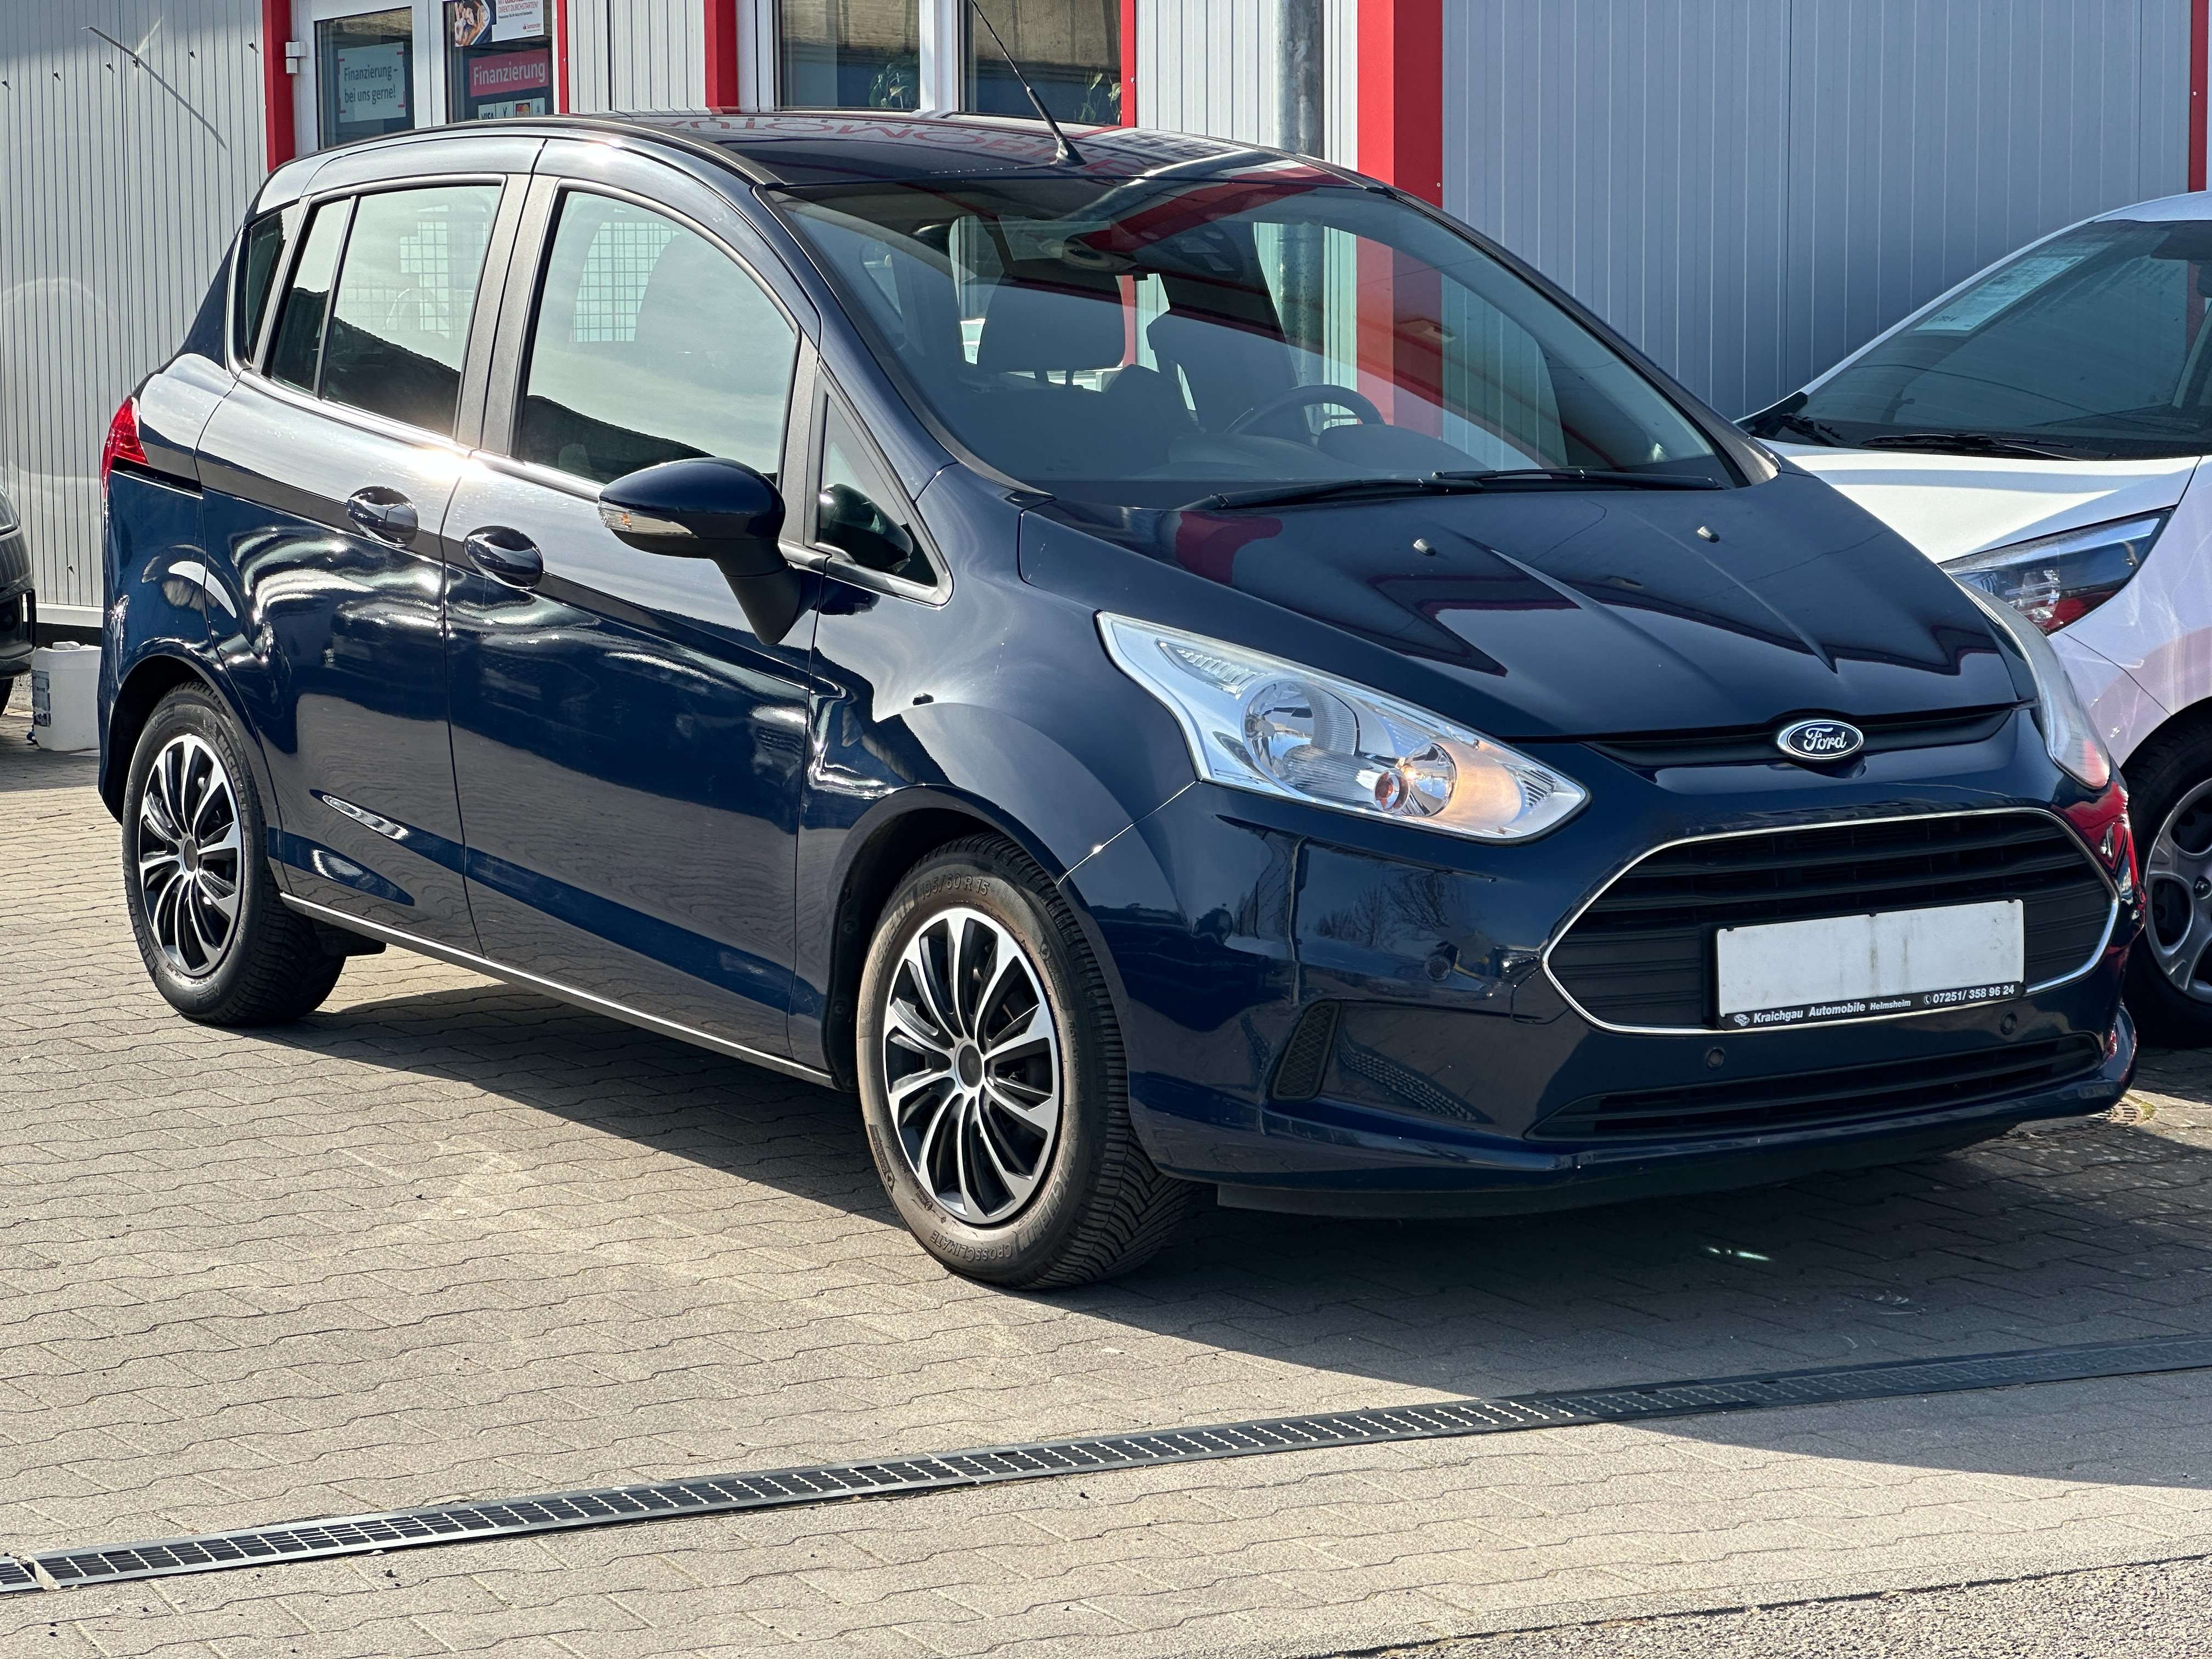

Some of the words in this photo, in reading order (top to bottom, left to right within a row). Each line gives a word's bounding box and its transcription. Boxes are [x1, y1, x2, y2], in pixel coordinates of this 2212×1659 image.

[344, 64, 392, 81] Finanzierung
[473, 61, 545, 86] Finanzierung
[345, 88, 356, 103] bei
[358, 90, 370, 101] uns
[372, 84, 396, 105] gerne!
[1804, 727, 1847, 751] Ford
[922, 873, 961, 900] 195/60
[964, 875, 973, 891] R
[976, 878, 990, 895] 15
[1753, 1009, 1803, 1023] Kraichgau
[1809, 1002, 1865, 1017] Automobile
[1870, 999, 1911, 1011] Helmsheim
[1933, 990, 1966, 1003] 07251/
[1968, 988, 1987, 998] 358
[1989, 986, 2001, 996] 96
[2003, 985, 2015, 994] 24
